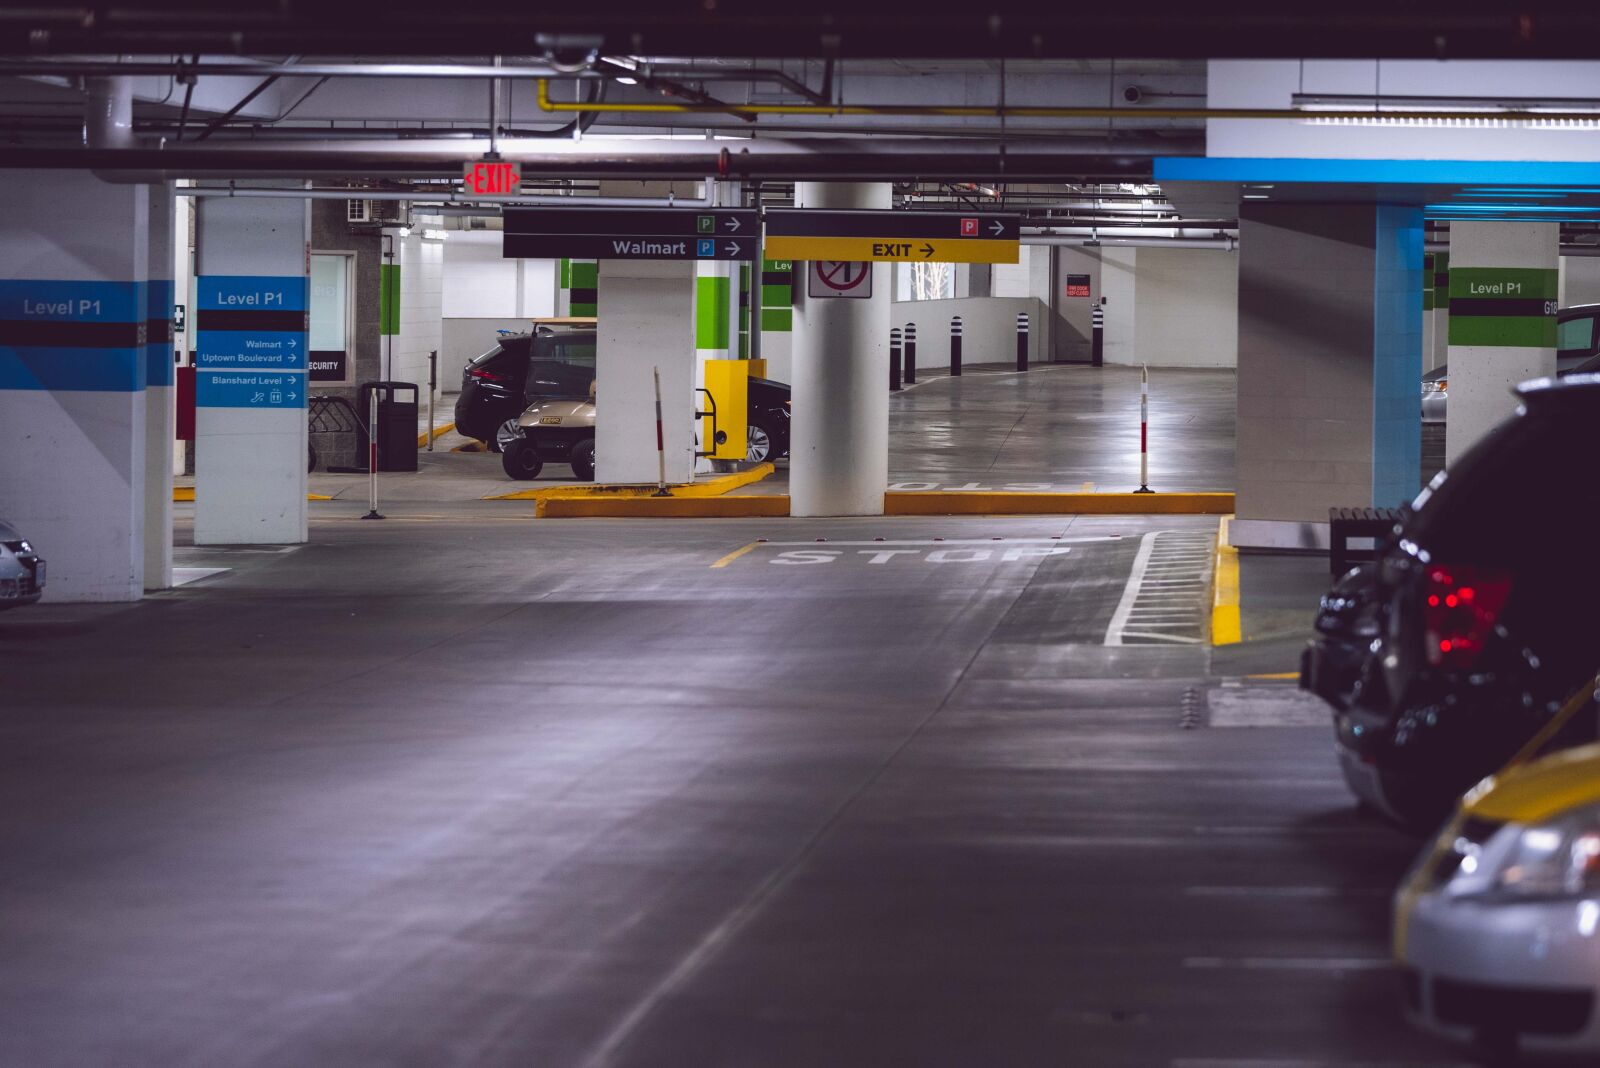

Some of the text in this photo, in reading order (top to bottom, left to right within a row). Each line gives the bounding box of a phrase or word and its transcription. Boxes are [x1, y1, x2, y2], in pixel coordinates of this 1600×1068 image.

[473, 163, 513, 193] EXIT
[612, 240, 686, 255] Walmart
[872, 243, 913, 257] EXIT
[774, 260, 793, 270] Lev
[1470, 282, 1522, 294] Level P1
[217, 291, 283, 305] Level P1
[23, 299, 101, 315] Level P1
[1543, 300, 1558, 315] G18
[245, 340, 282, 349] Walmart
[202, 353, 283, 364] Uptown Boulevard
[308, 361, 339, 370] ECURITY
[212, 376, 282, 385] Blanshard Level
[887, 482, 1055, 491] STO
[768, 547, 1071, 565] STOP
